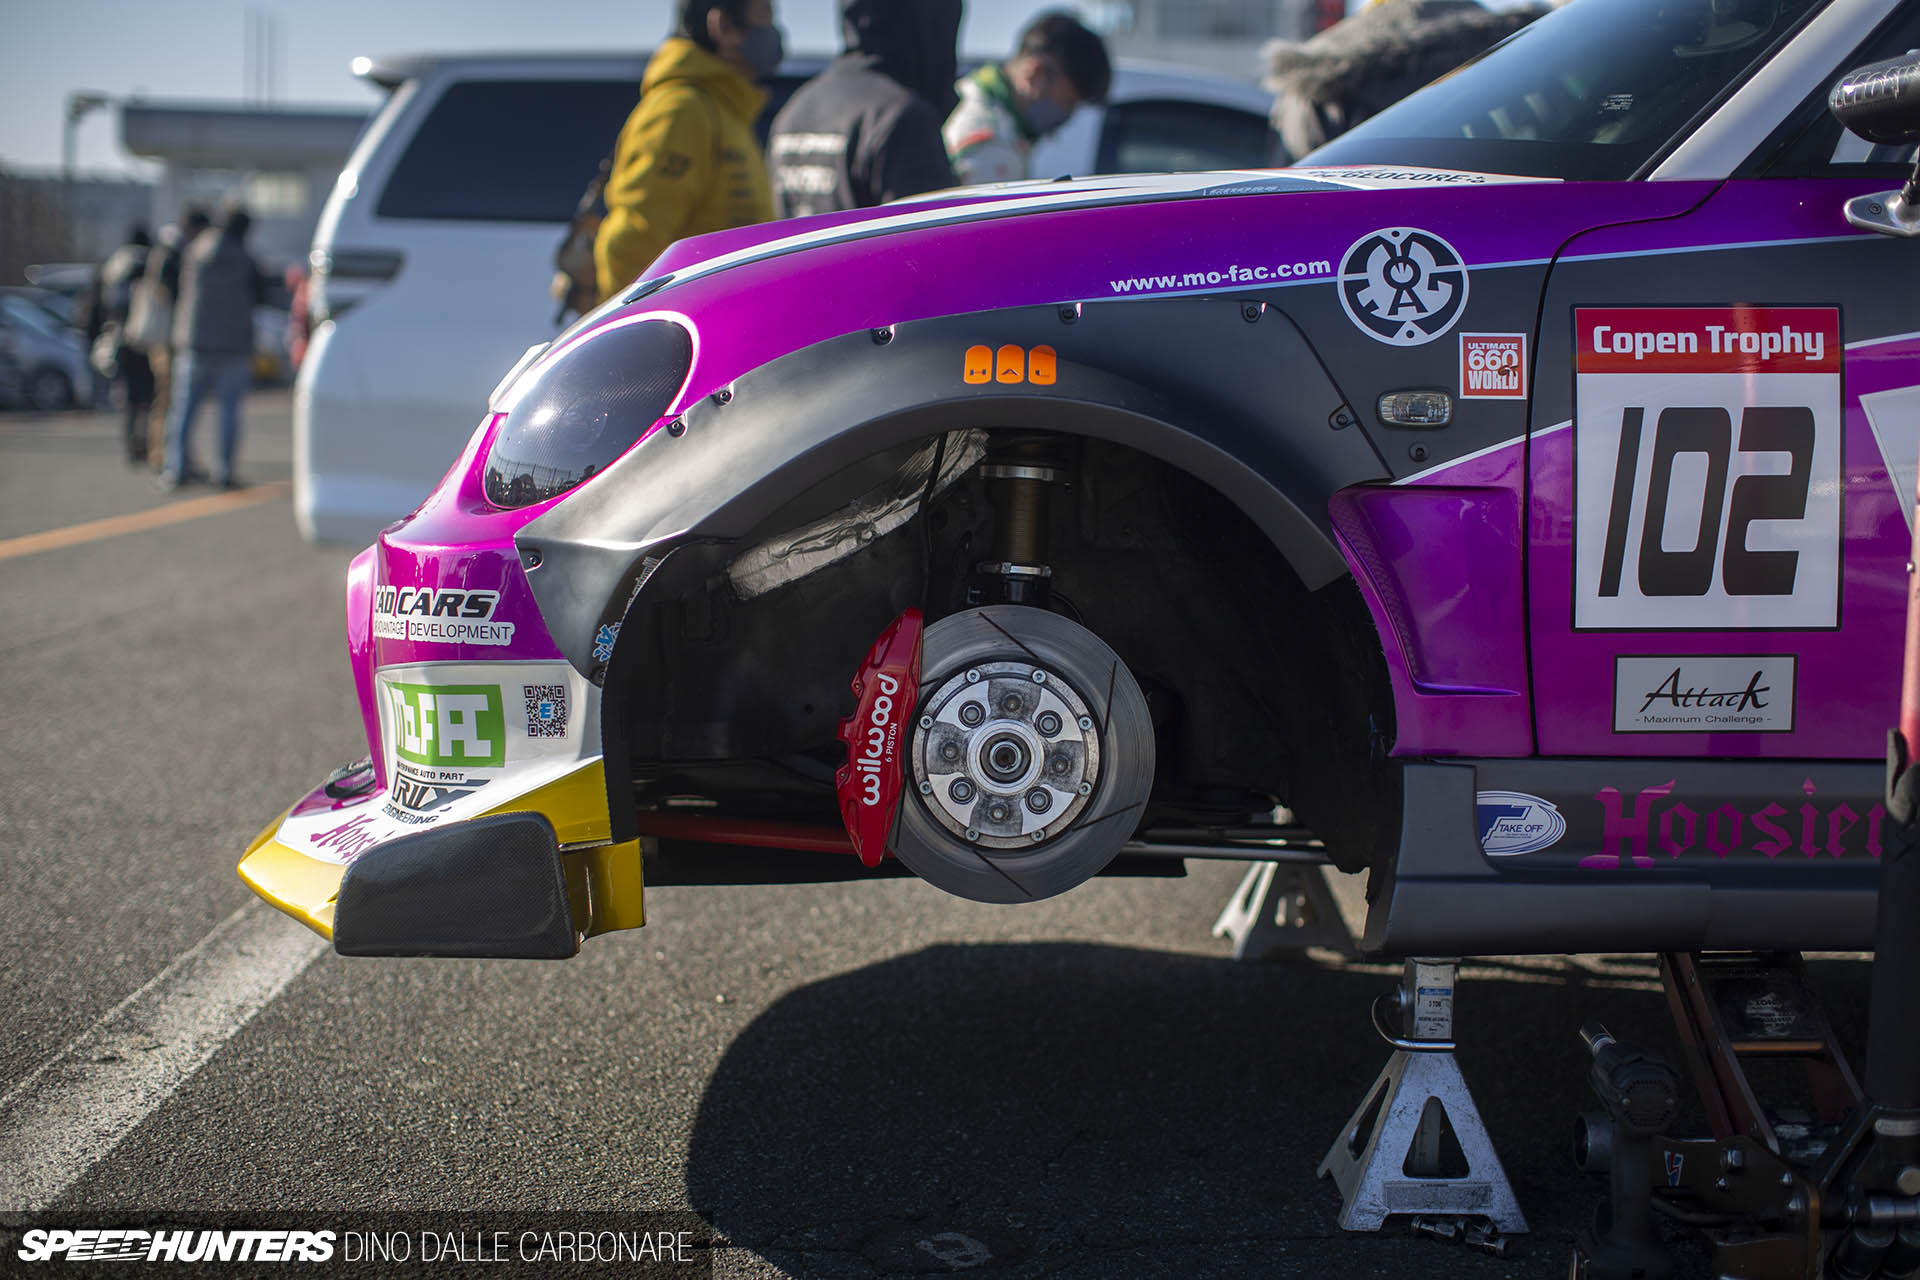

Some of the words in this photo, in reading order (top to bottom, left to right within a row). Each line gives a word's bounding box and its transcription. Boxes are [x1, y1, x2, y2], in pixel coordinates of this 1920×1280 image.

[1110, 259, 1331, 292] www.mo-fac.com
[1593, 325, 1698, 360] Copen
[1705, 325, 1825, 360] Trophy
[1468, 350, 1518, 370] 660
[1468, 371, 1518, 390] WORLD
[1598, 407, 1816, 597] 102
[398, 592, 496, 618] CARS
[410, 622, 511, 640] DEVELOPMENT
[1639, 667, 1770, 713] Attack
[1644, 715, 1700, 723] Maximum
[1705, 715, 1763, 724] Challenge
[857, 673, 898, 806] wilwood
[886, 722, 898, 756] PISTON
[440, 772, 464, 781] PART
[1500, 824, 1523, 833] TAKE
[1524, 824, 1544, 833] OFF
